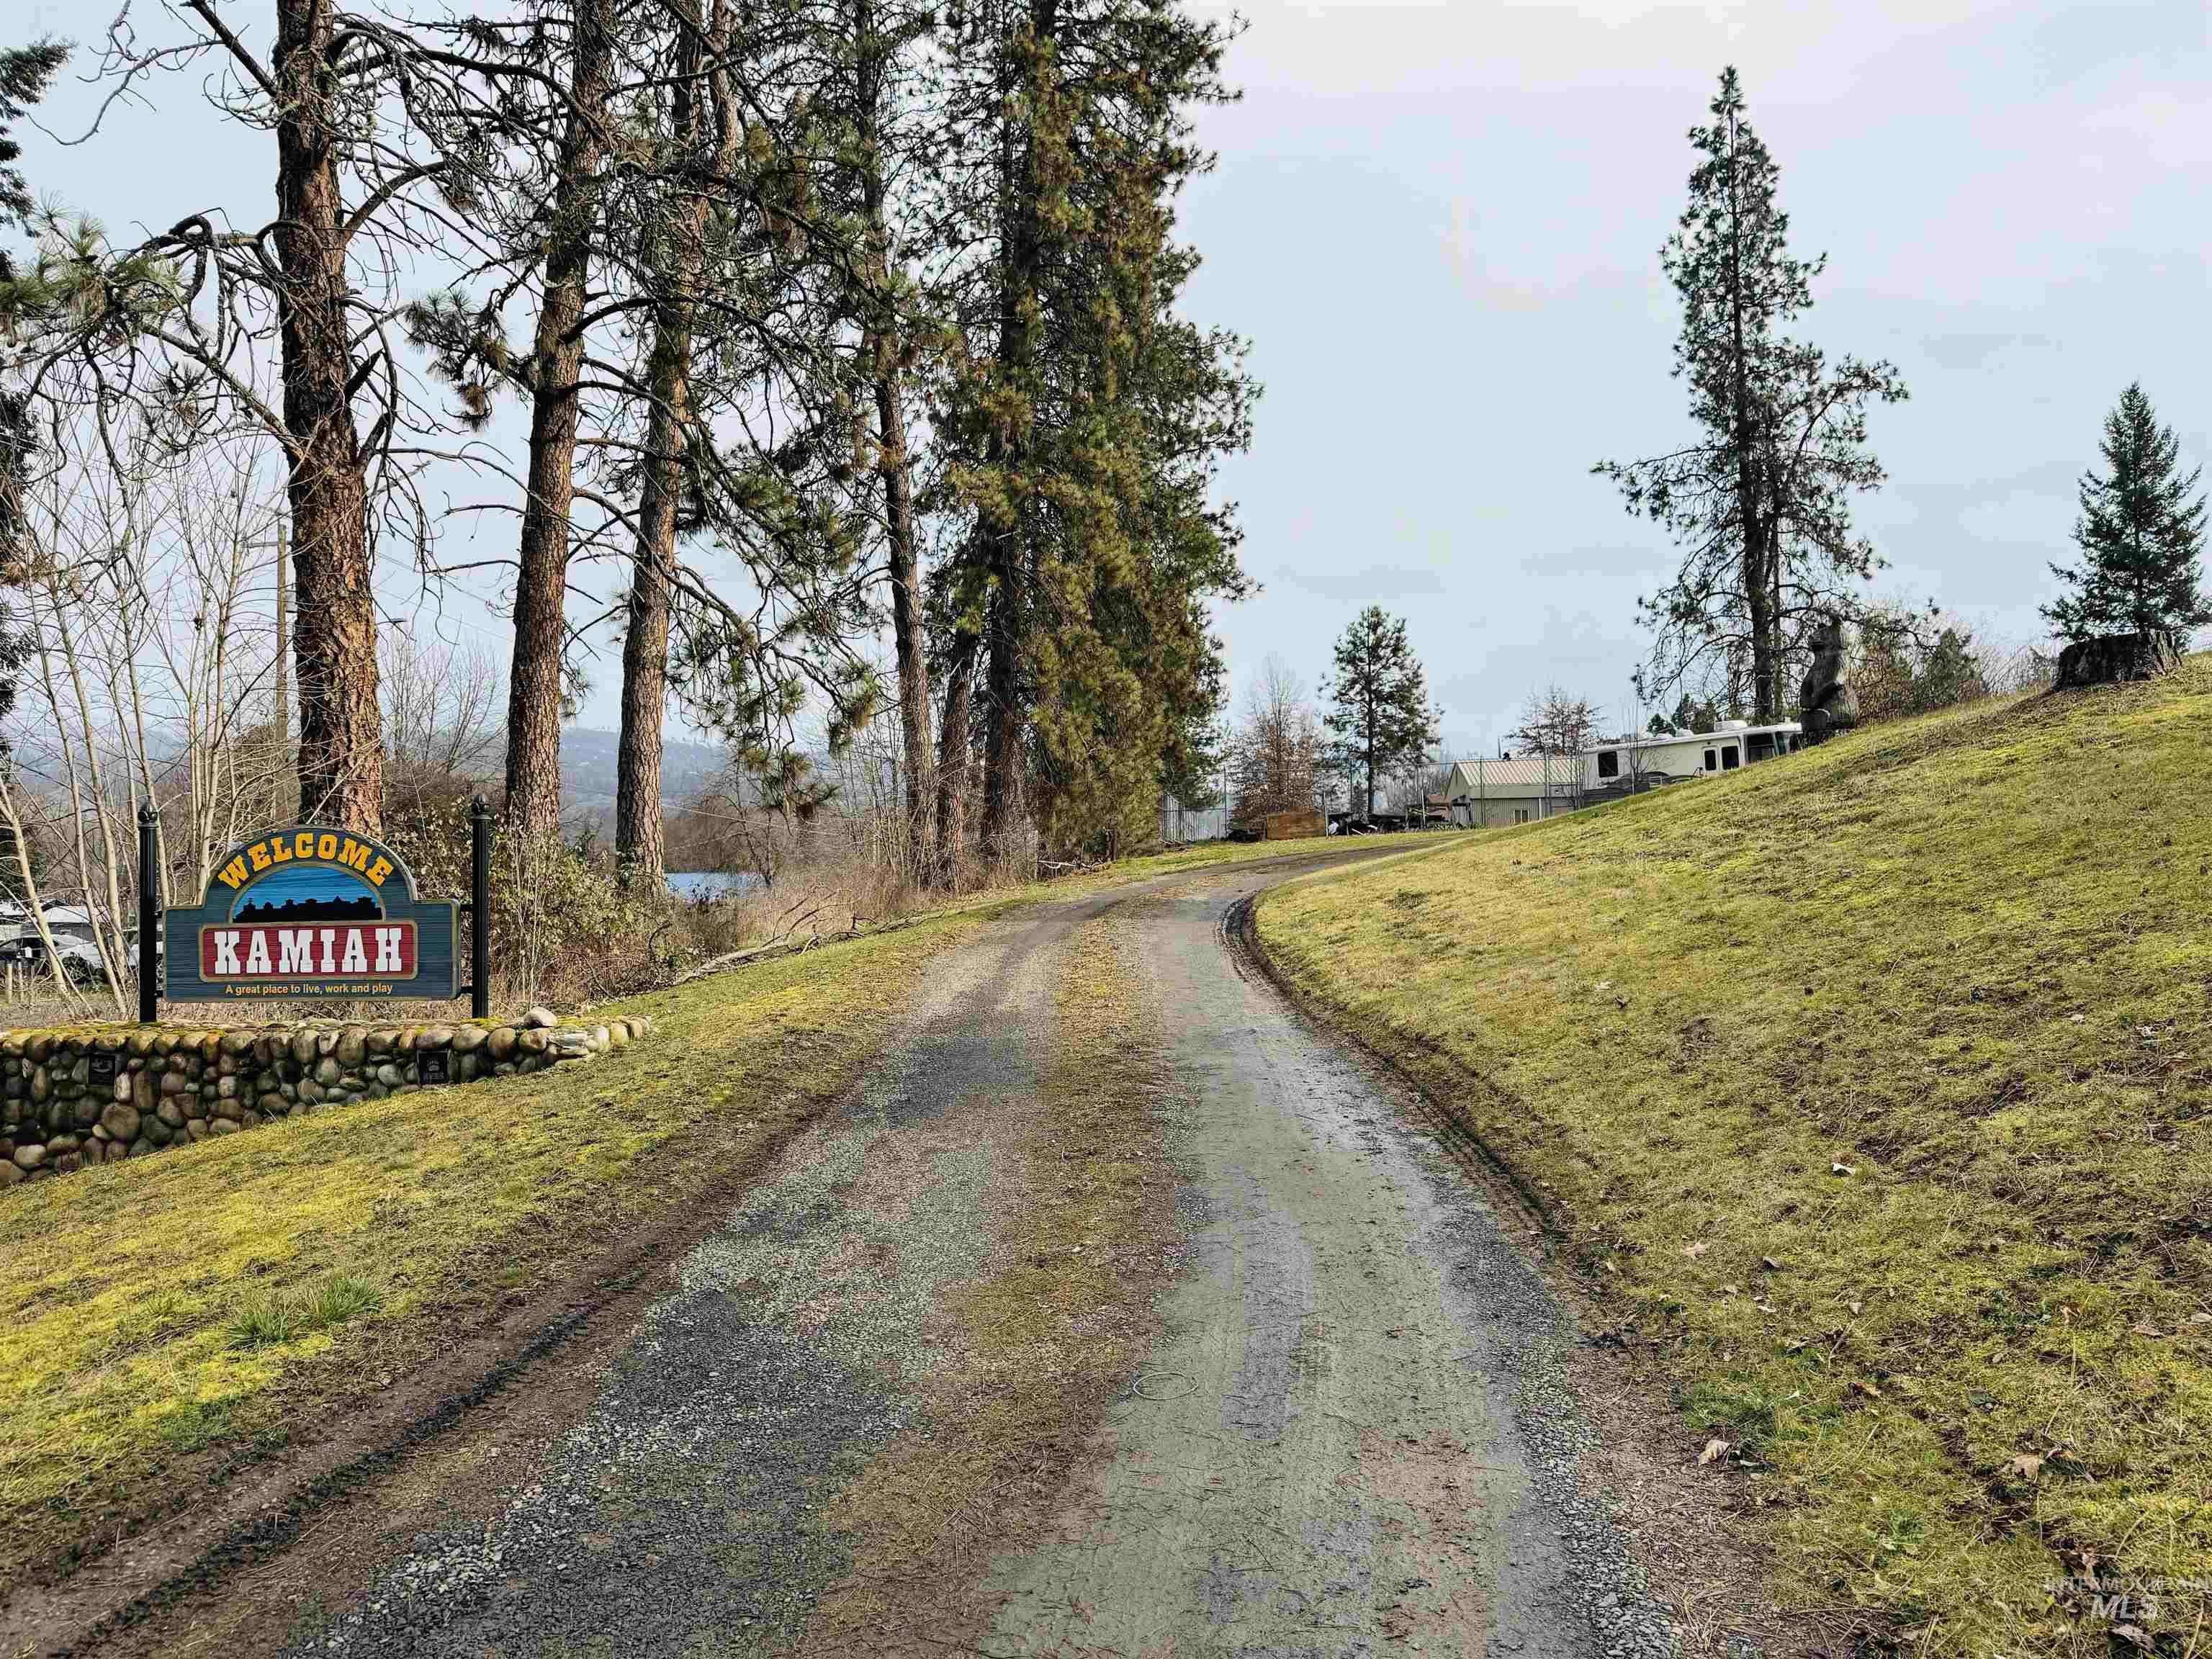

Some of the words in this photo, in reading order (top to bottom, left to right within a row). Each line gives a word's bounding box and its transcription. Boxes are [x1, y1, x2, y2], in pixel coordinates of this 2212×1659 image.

[217, 832, 394, 889] WELCOME
[214, 927, 403, 975] KAMIAH
[225, 984, 233, 994] A
[235, 984, 260, 996] great
[263, 984, 288, 995] place
[290, 984, 300, 994] to
[303, 984, 323, 994] live,
[325, 984, 349, 993] work
[351, 984, 369, 993] and
[372, 984, 392, 994] play
